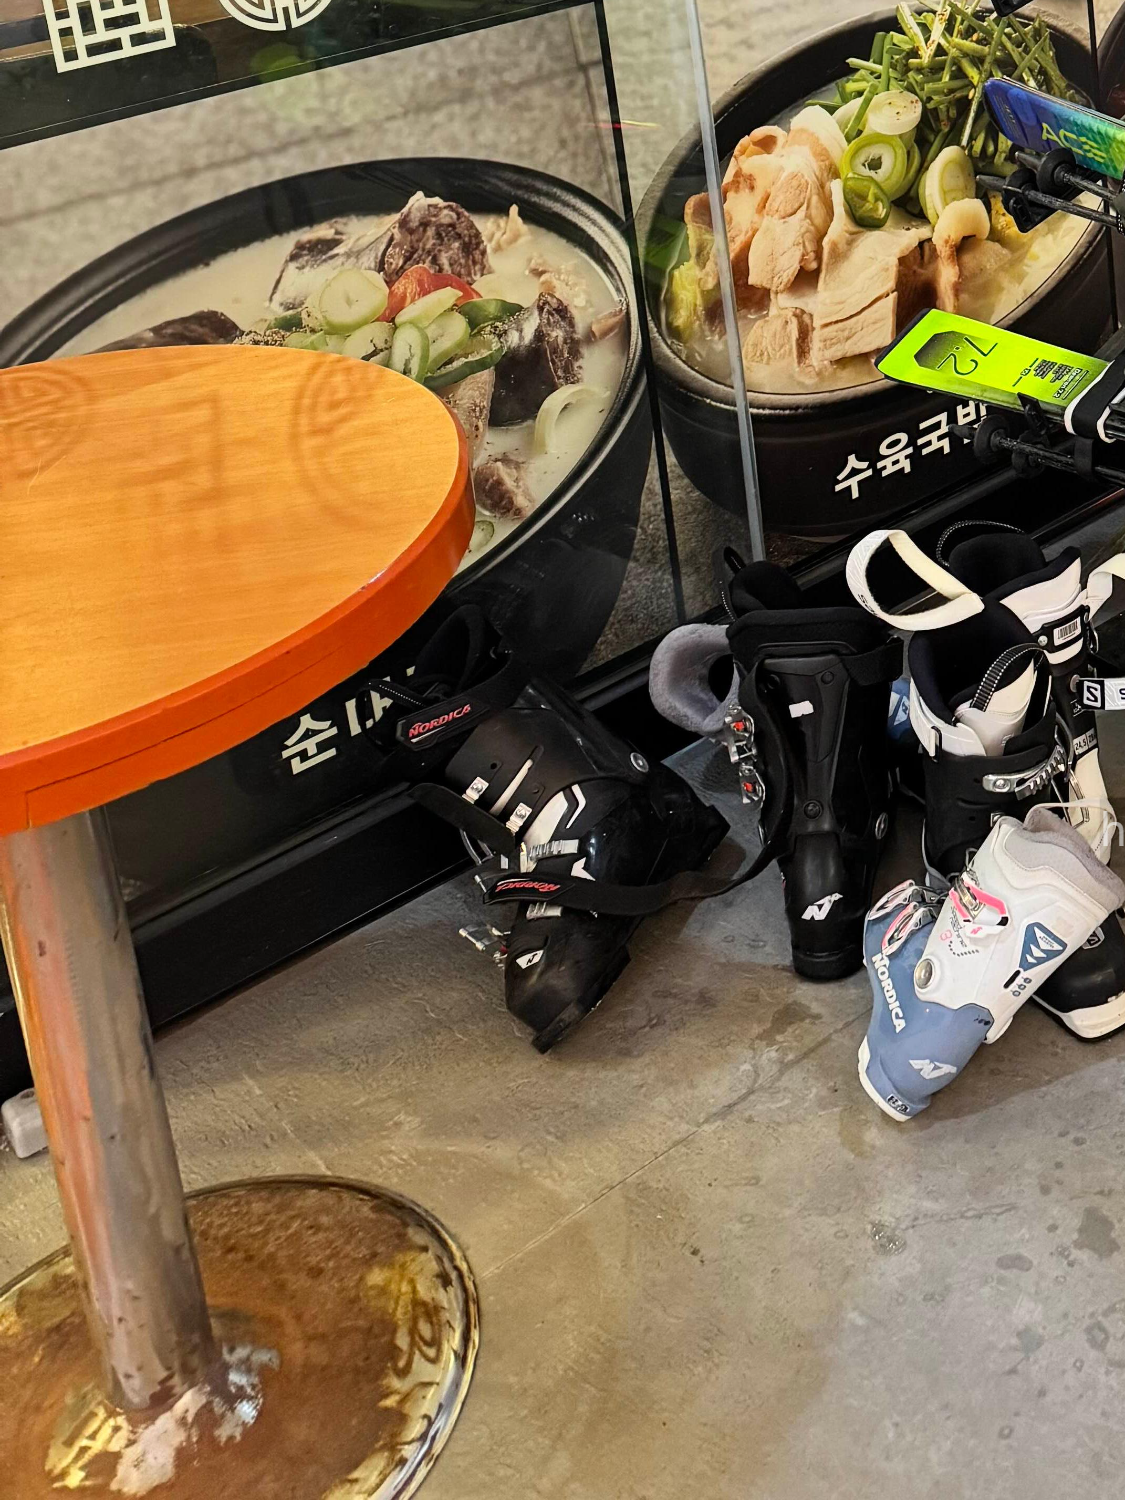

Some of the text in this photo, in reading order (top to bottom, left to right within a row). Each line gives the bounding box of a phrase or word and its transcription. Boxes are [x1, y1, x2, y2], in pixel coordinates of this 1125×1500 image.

[408, 703, 472, 738] NORDICA
[494, 878, 562, 892] NORDICA
[871, 952, 907, 1034] NORDICA
